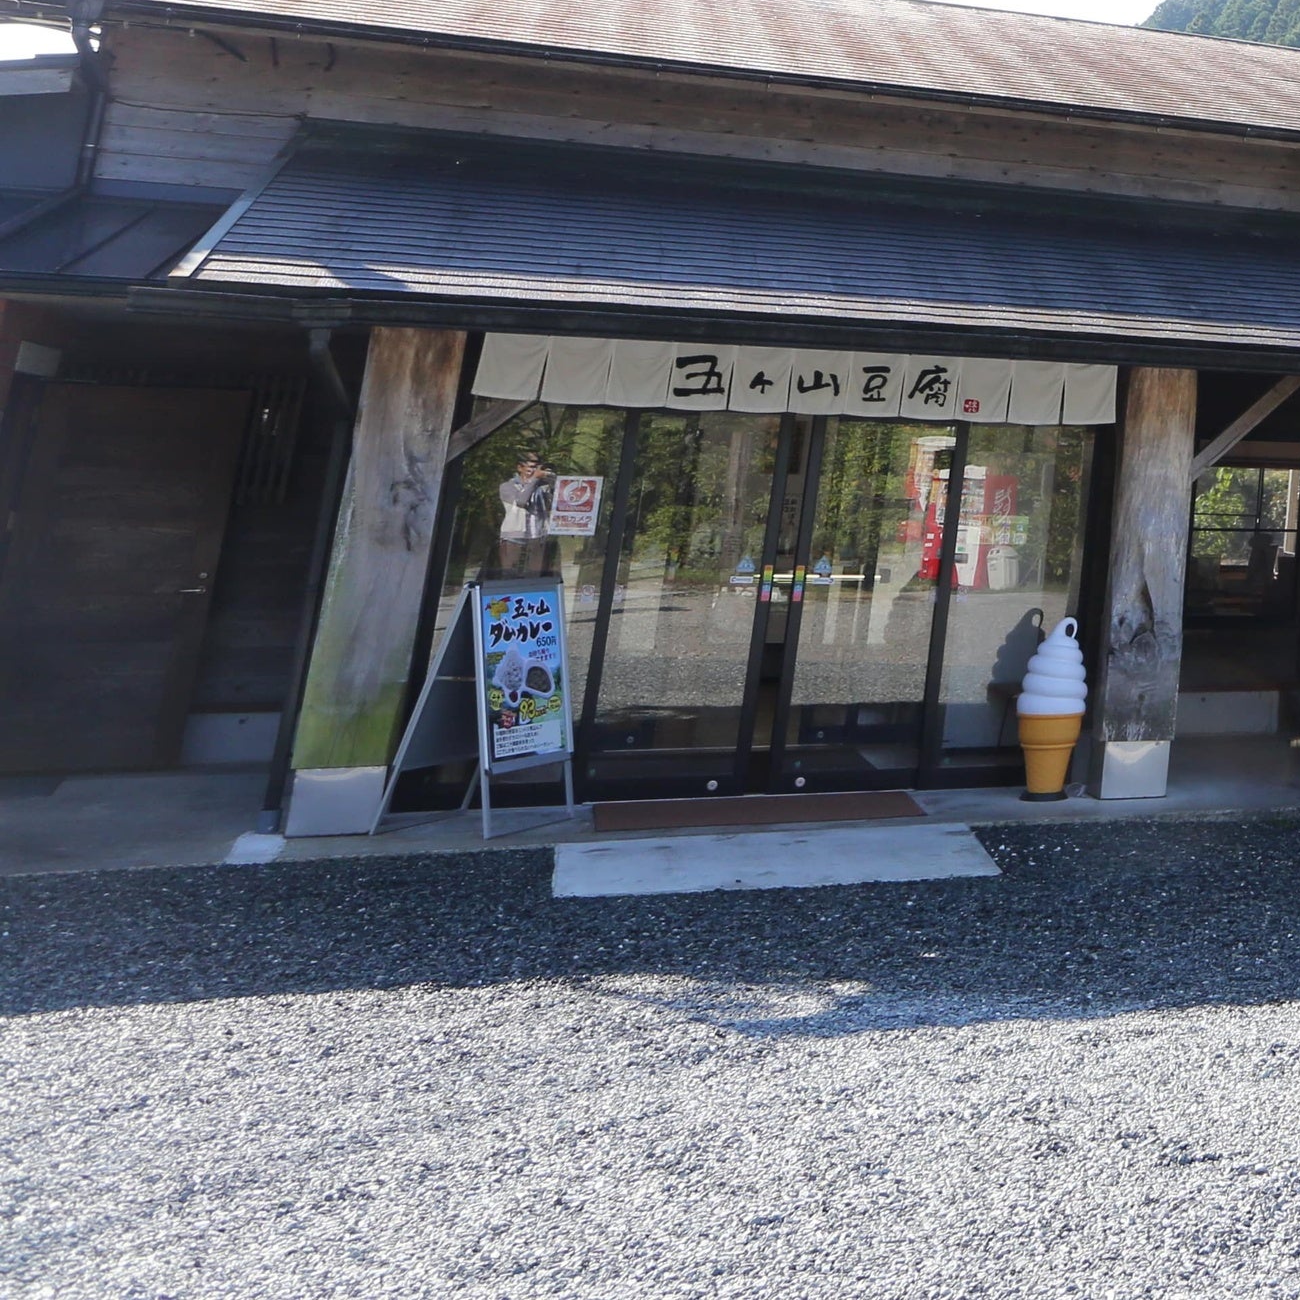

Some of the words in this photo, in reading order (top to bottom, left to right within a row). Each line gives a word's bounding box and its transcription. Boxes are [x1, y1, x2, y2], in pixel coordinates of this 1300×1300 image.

[490, 619, 552, 648] ダムカレー
